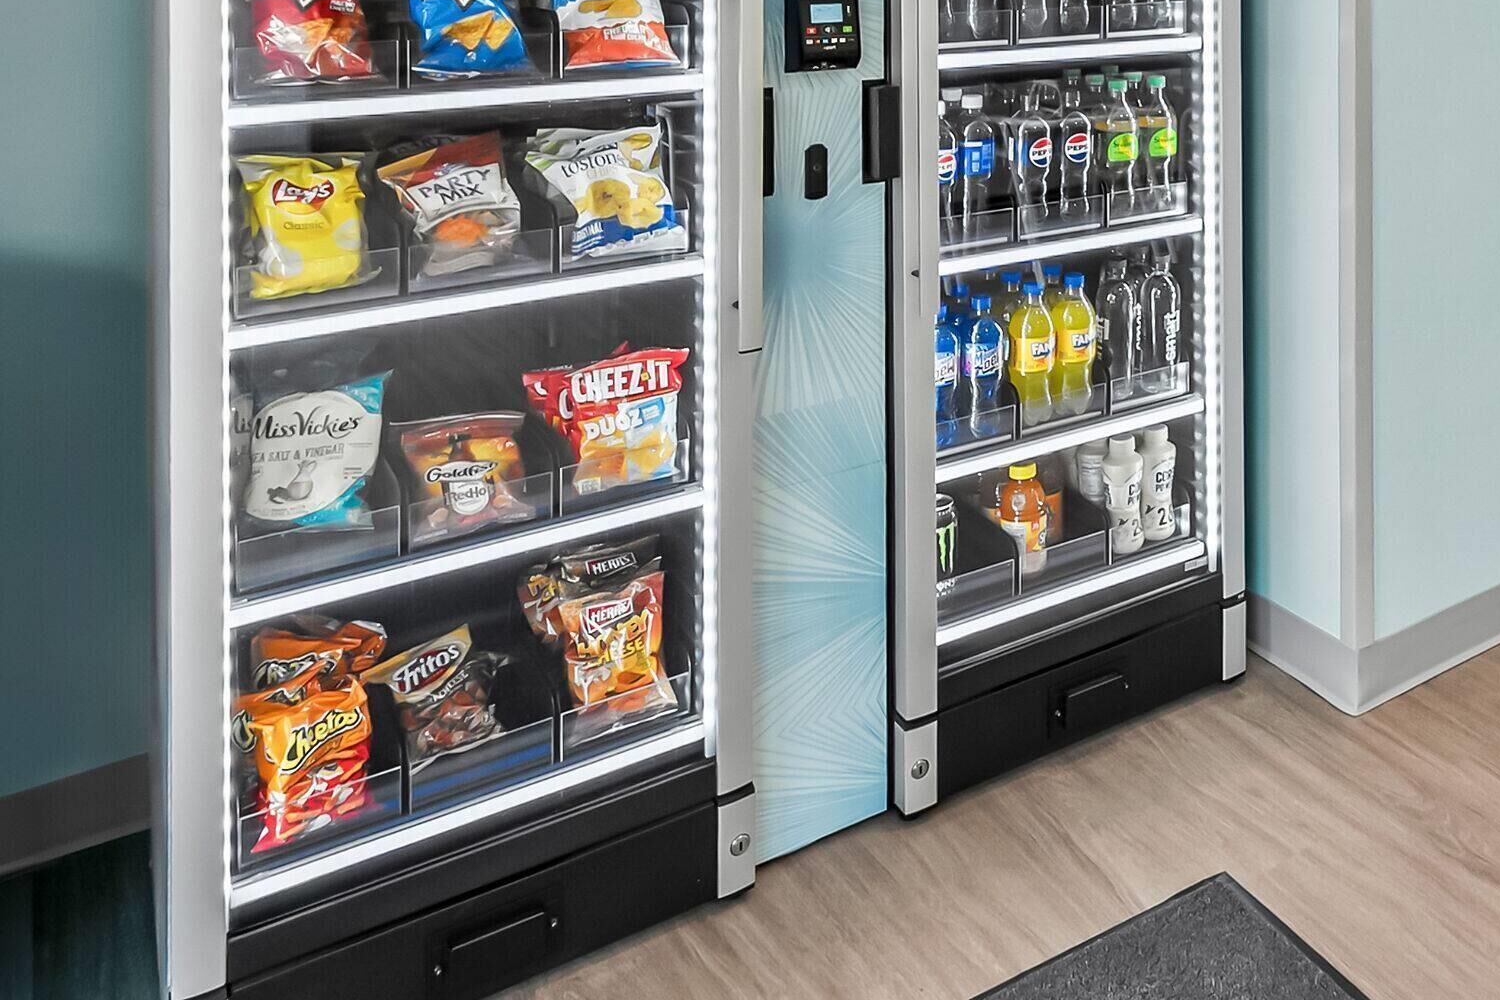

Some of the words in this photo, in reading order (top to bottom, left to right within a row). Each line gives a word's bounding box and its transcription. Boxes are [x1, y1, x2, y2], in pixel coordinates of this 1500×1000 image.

[418, 169, 490, 198] PARTY
[440, 183, 484, 205] MIX
[253, 415, 297, 440] Miss
[293, 405, 363, 440] Vickie's
[268, 450, 291, 462] SALT
[305, 443, 345, 459] VINEGAR
[450, 487, 487, 502] RedHo
[392, 644, 460, 693] Fritos
[281, 707, 359, 771] Cheetos
